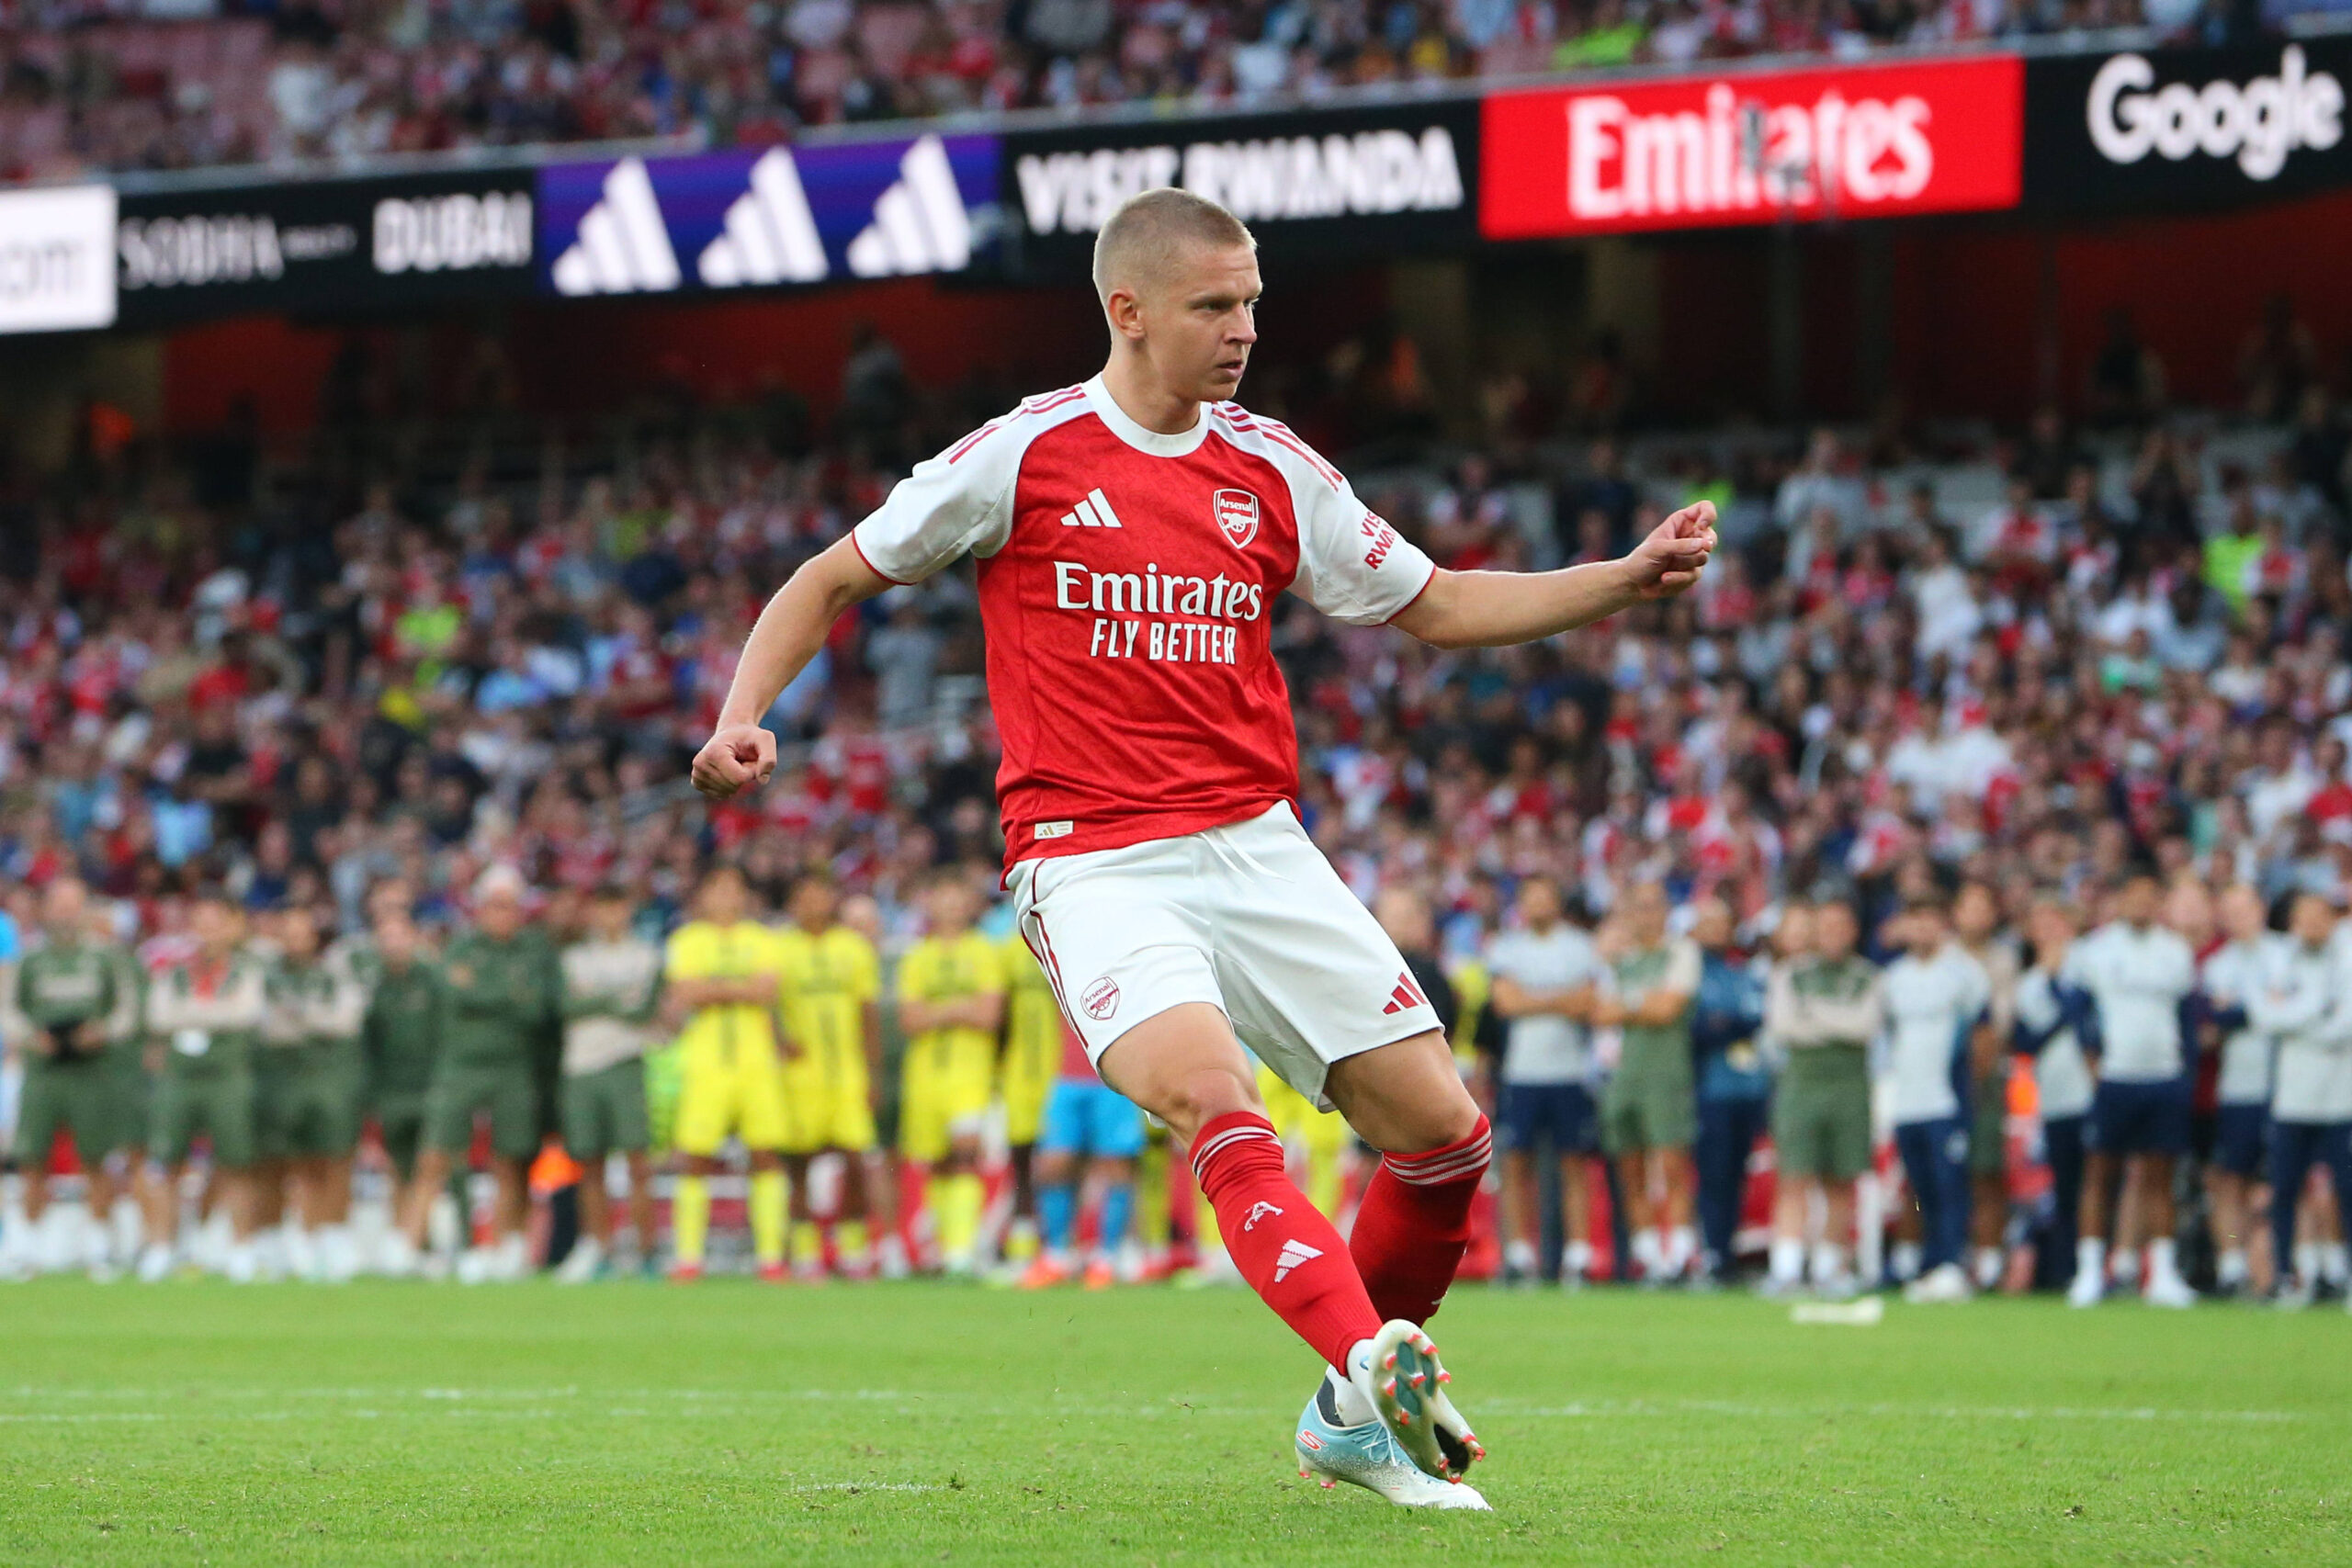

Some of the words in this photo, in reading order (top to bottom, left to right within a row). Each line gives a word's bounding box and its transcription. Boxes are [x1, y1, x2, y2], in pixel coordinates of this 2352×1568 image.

[2089, 43, 2342, 180] Google
[1017, 146, 1180, 234] VISIT
[1183, 127, 1463, 221] RWANDA
[373, 190, 533, 273] DUBAI
[1220, 498, 1252, 512] Arsenal
[1054, 561, 1262, 621] Emirates
[1091, 618, 1140, 659] FLY
[1148, 622, 1237, 665] BETTER
[1085, 983, 1111, 1004] Arsenal
